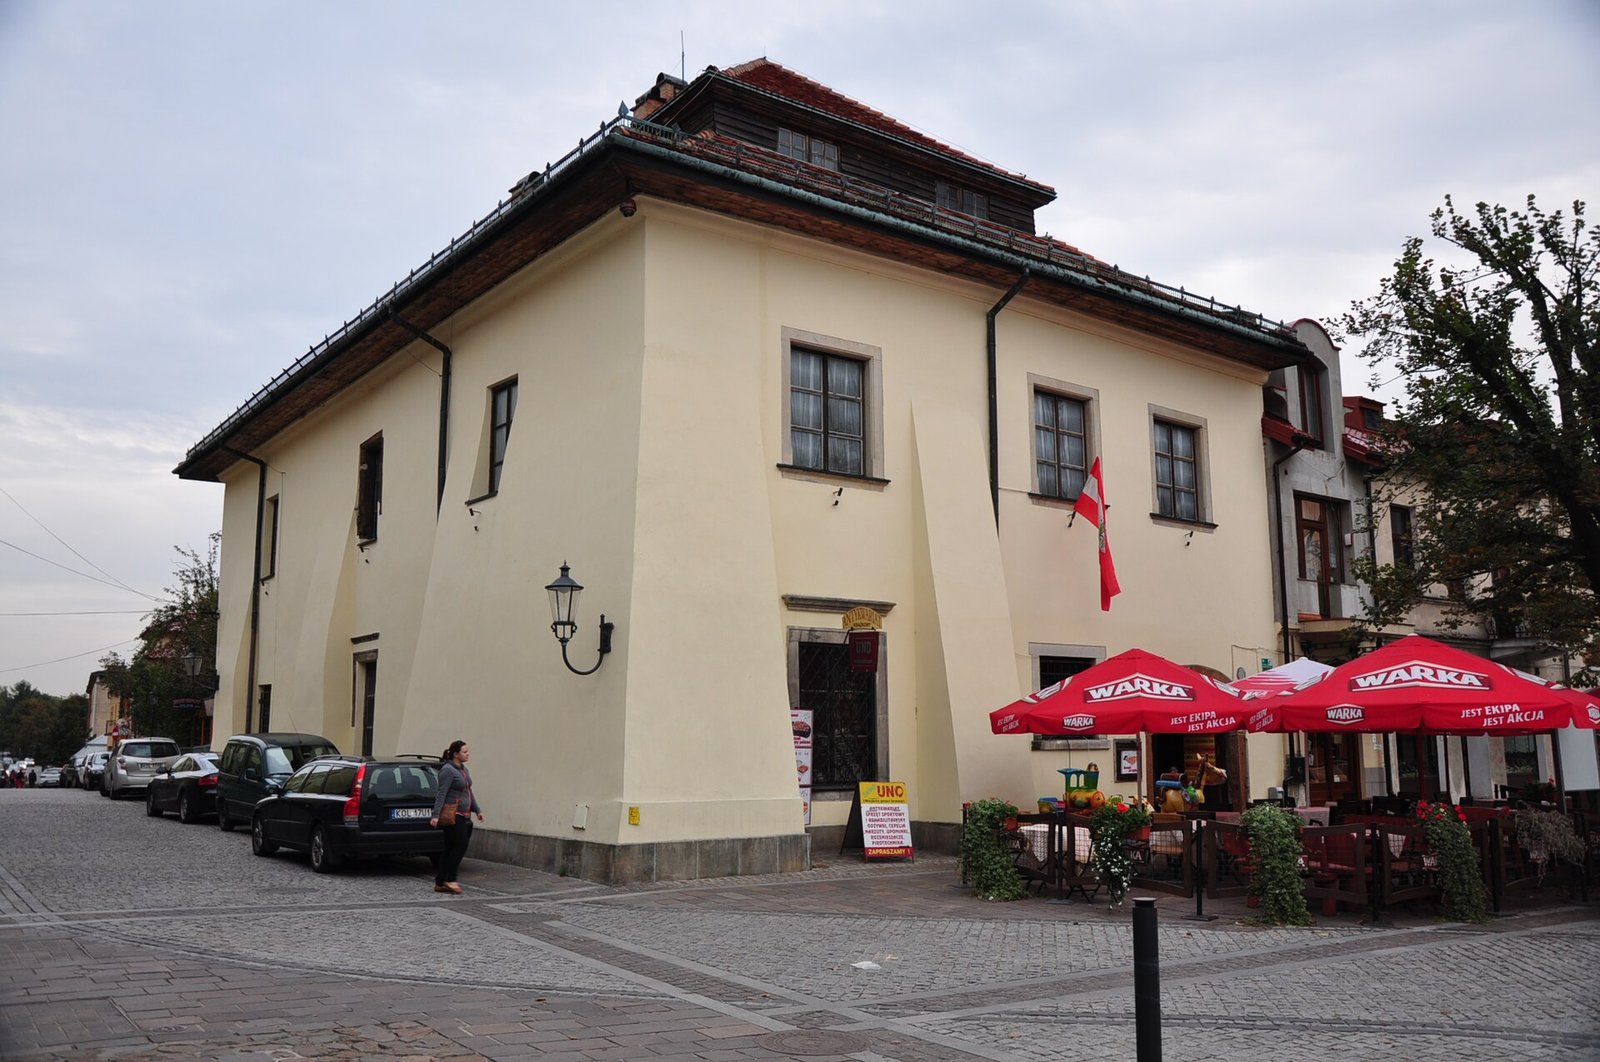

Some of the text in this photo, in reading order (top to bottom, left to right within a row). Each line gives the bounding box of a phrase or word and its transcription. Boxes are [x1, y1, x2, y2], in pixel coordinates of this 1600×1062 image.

[856, 640, 871, 654] UNO
[1355, 666, 1483, 687] WARKA
[1088, 678, 1188, 699] WARKA
[1171, 711, 1217, 725] JEST EKIPA
[1327, 707, 1363, 720] WARKA
[1461, 704, 1520, 718] JEST EKIPA
[1064, 717, 1094, 727] WARKA
[1188, 717, 1236, 732] JEST AKCJA
[1483, 710, 1544, 727] JEST AKCJA
[877, 785, 904, 797] UNO
[396, 809, 411, 817] KOL
